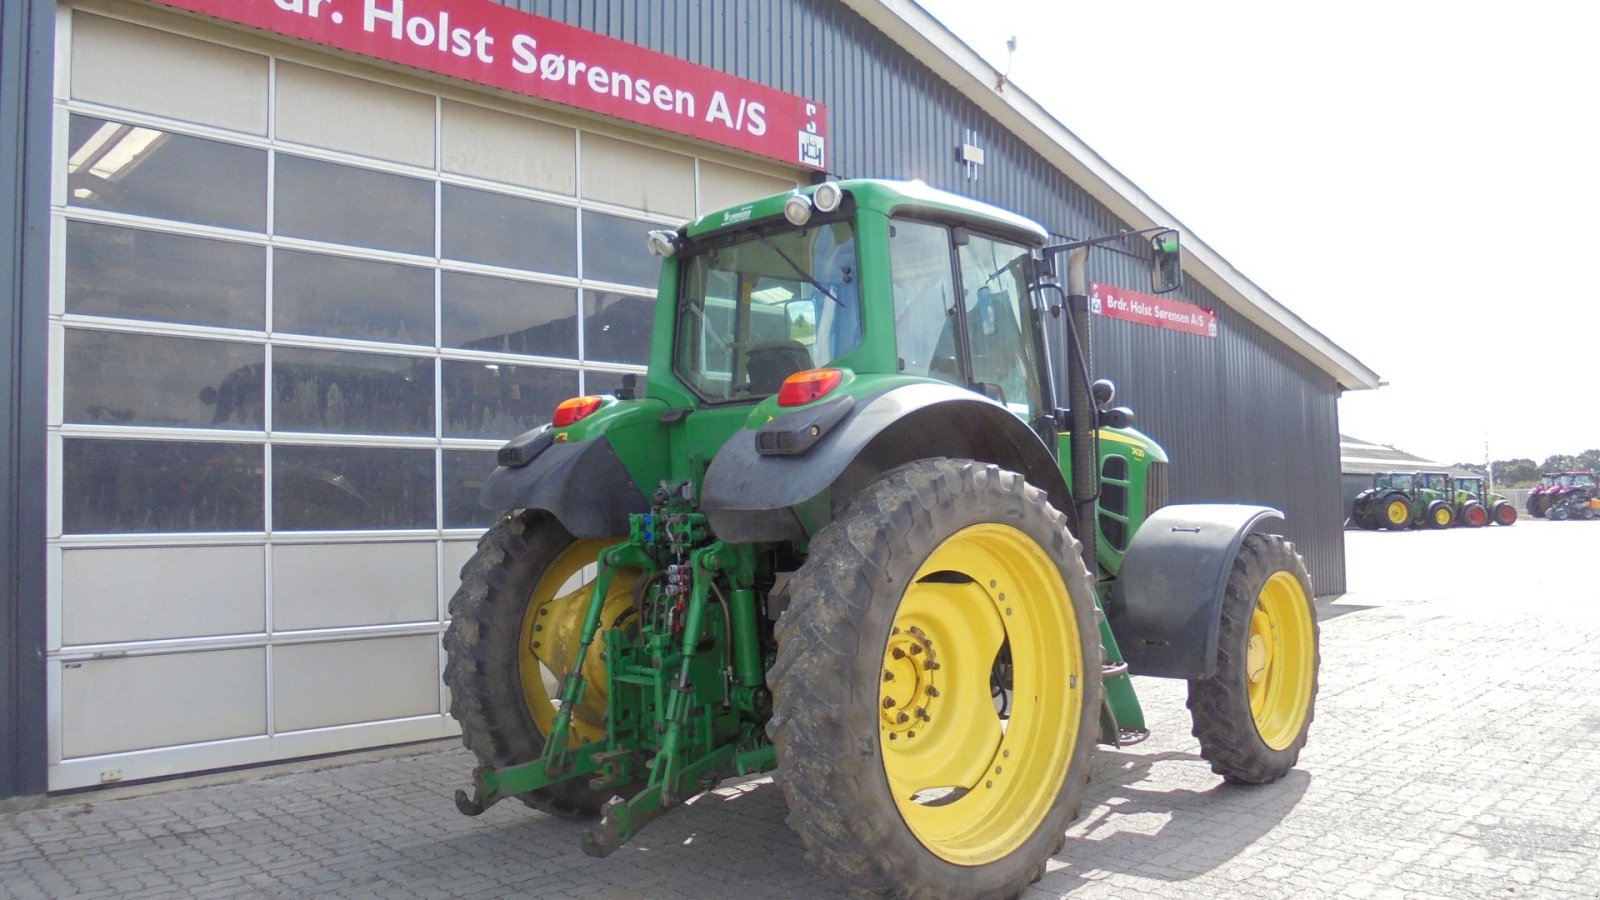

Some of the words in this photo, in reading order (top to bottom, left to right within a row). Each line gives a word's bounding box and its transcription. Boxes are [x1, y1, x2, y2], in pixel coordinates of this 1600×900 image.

[363, 0, 494, 64] Holst
[511, 34, 695, 118] Sørensen
[705, 90, 767, 136] A/S
[1107, 294, 1129, 311] Brdr.
[1130, 300, 1153, 316] Holst
[1154, 306, 1190, 324] Sørensen
[1190, 313, 1204, 327] A/S
